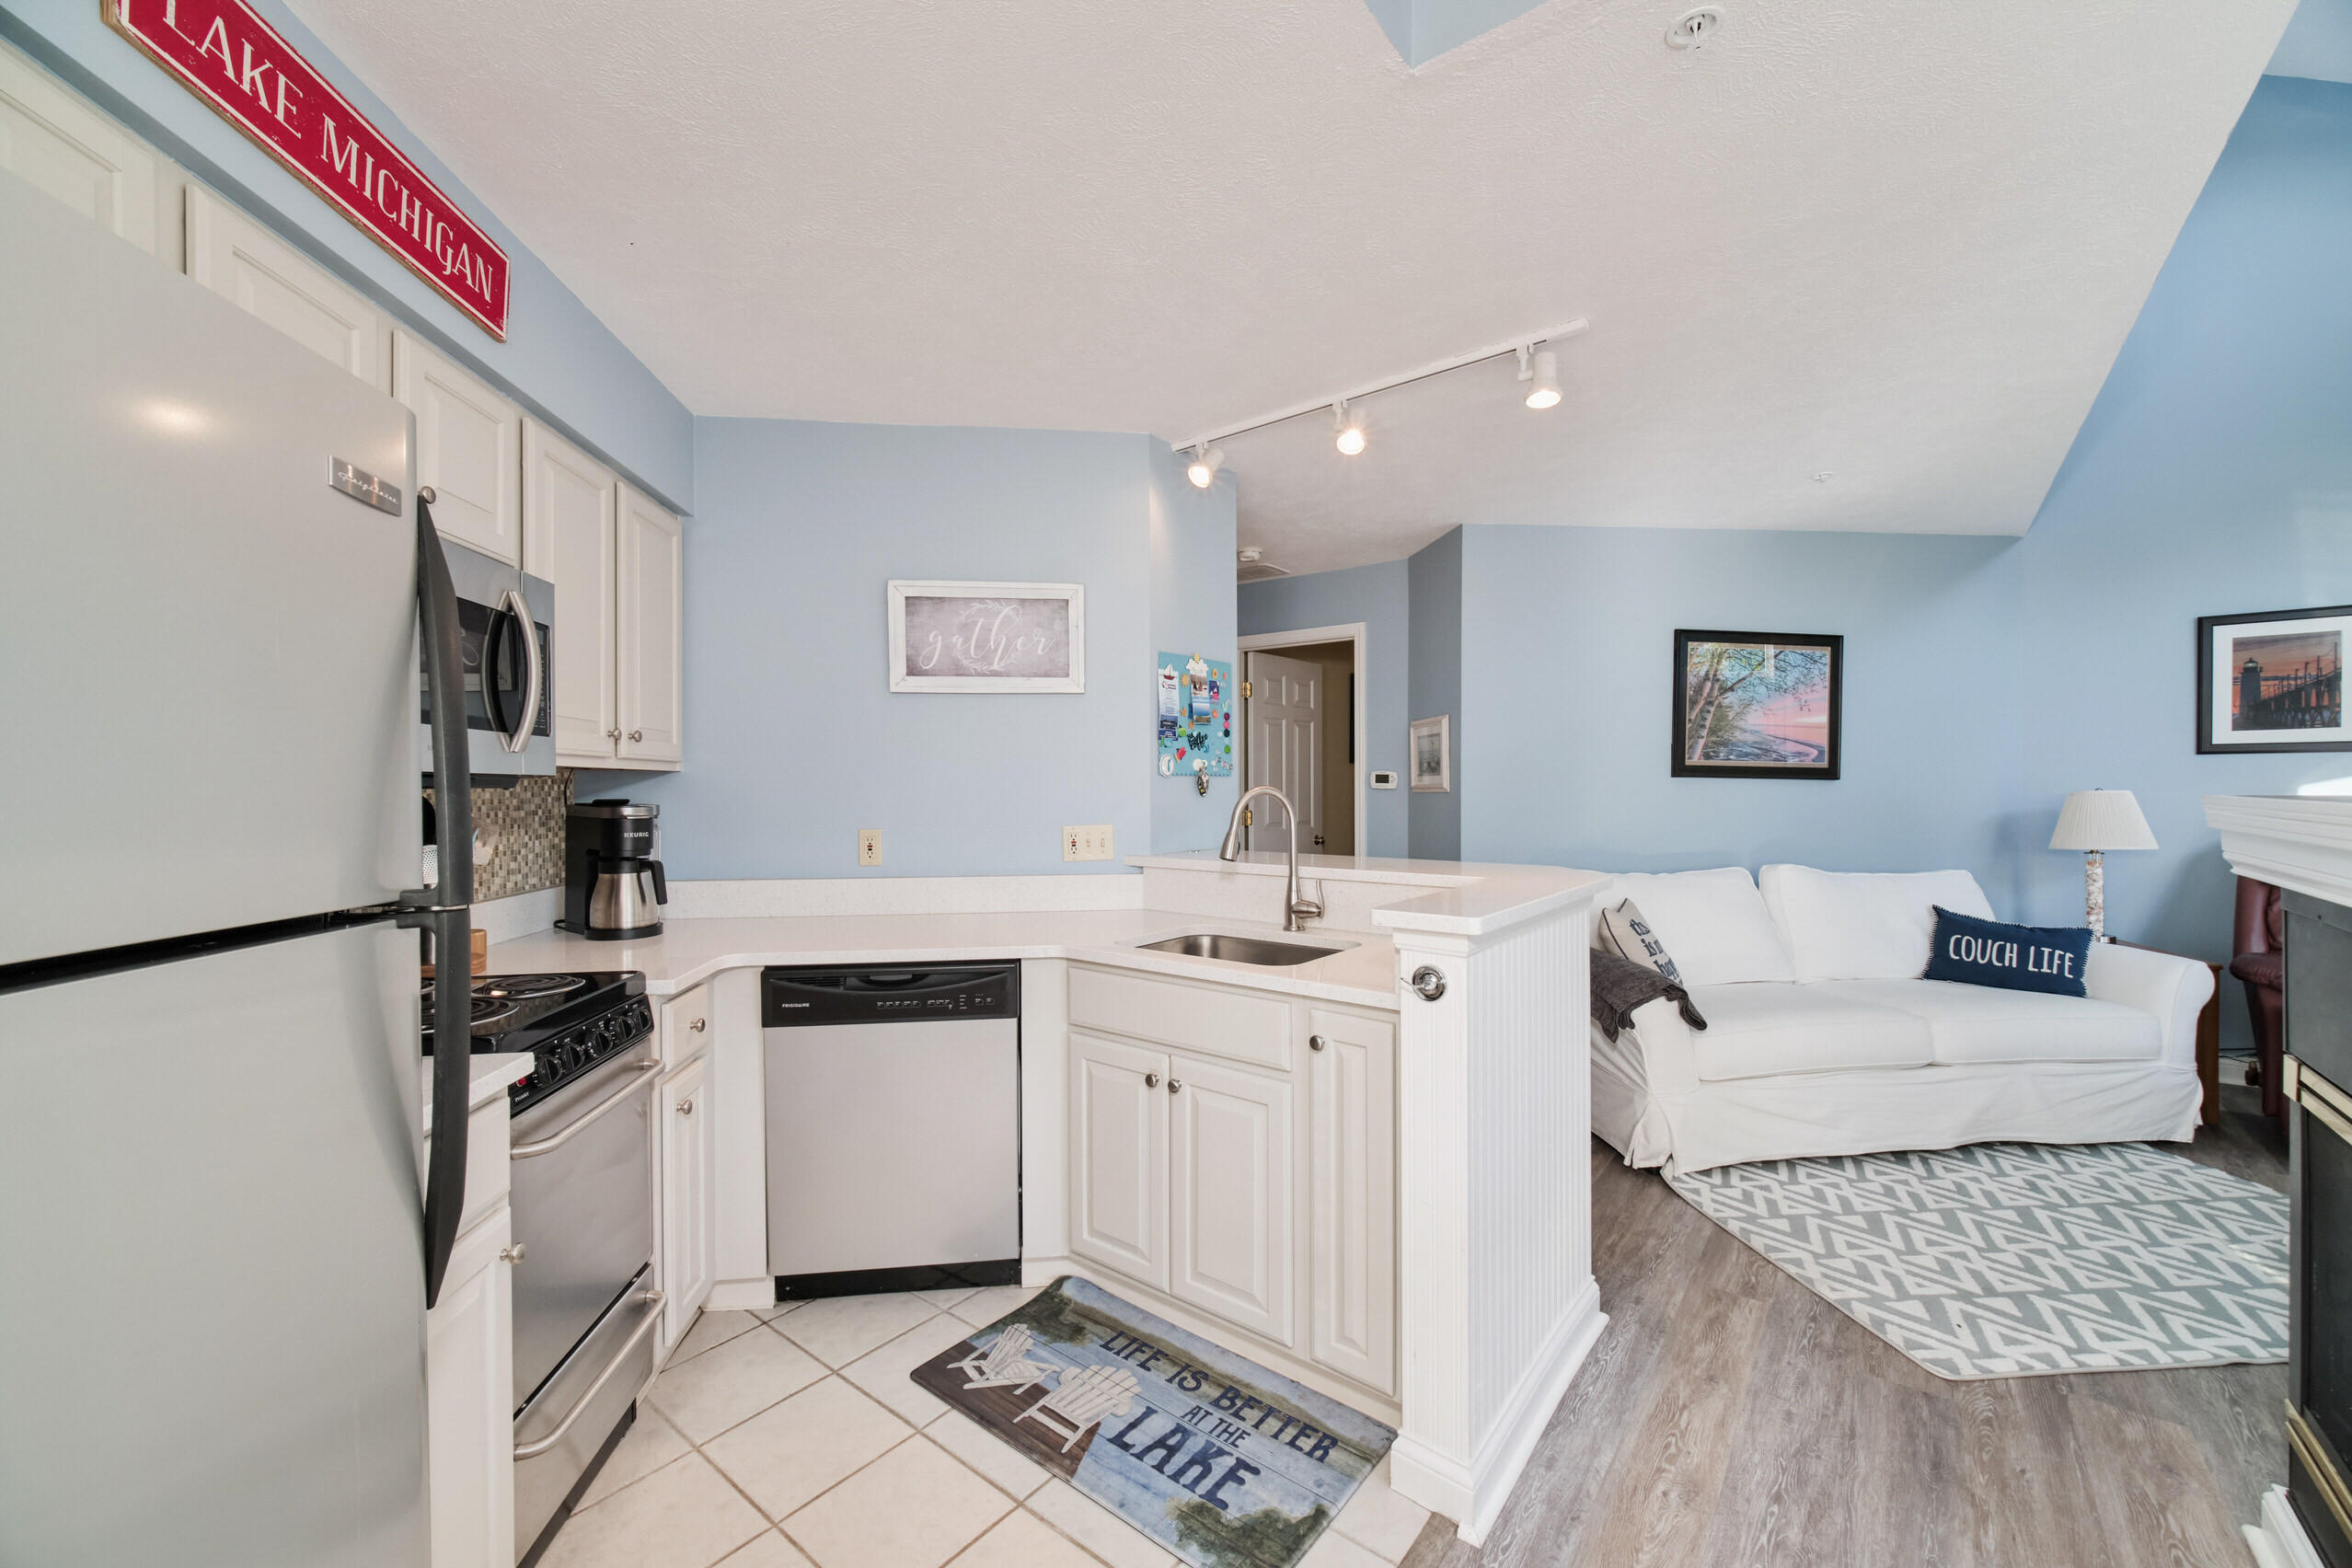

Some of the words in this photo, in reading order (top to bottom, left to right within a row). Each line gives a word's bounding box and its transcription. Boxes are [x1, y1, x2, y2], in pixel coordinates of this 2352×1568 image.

[163, 0, 303, 139] LAKE
[321, 112, 493, 303] MICHIGAN
[919, 605, 1055, 670] gather
[1949, 934, 2018, 968] COUCH
[2027, 945, 2074, 978] LIFE
[1100, 1330, 1170, 1372] LIFE
[1165, 1363, 1209, 1391] IS
[1208, 1385, 1339, 1464] BETTER
[1180, 1404, 1214, 1426] AT
[1206, 1417, 1251, 1448] THE
[1106, 1405, 1262, 1511] LAKE
